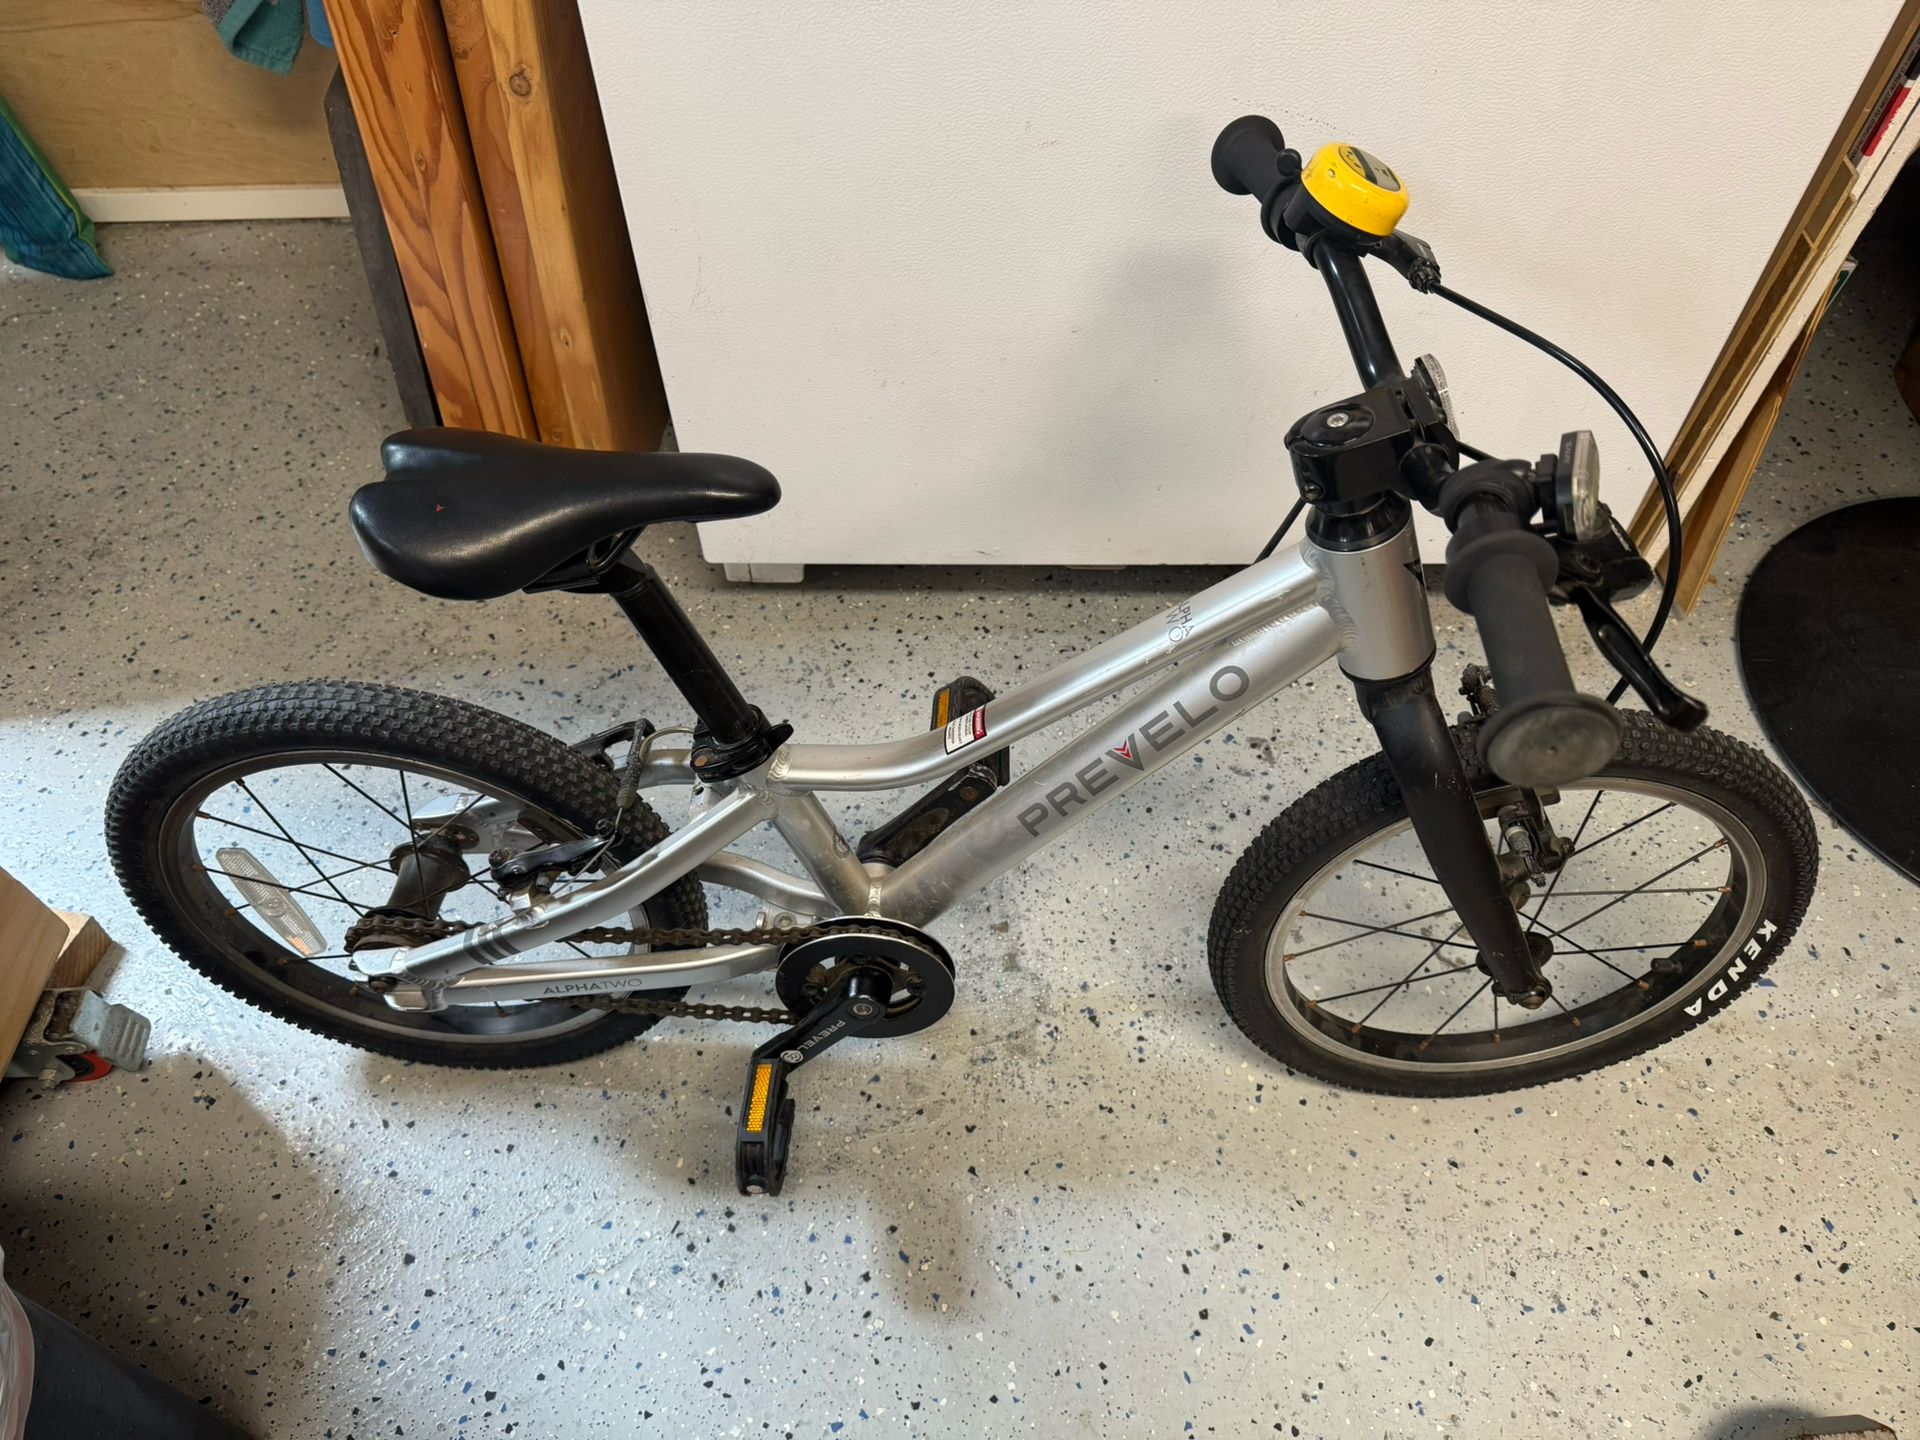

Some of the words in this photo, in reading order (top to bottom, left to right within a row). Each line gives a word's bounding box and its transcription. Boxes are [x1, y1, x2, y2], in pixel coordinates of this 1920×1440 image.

[1166, 608, 1184, 642] WO
[1178, 600, 1195, 637] LPHA
[1016, 665, 1250, 837] PREVELO
[1683, 919, 1778, 1017] KENDA
